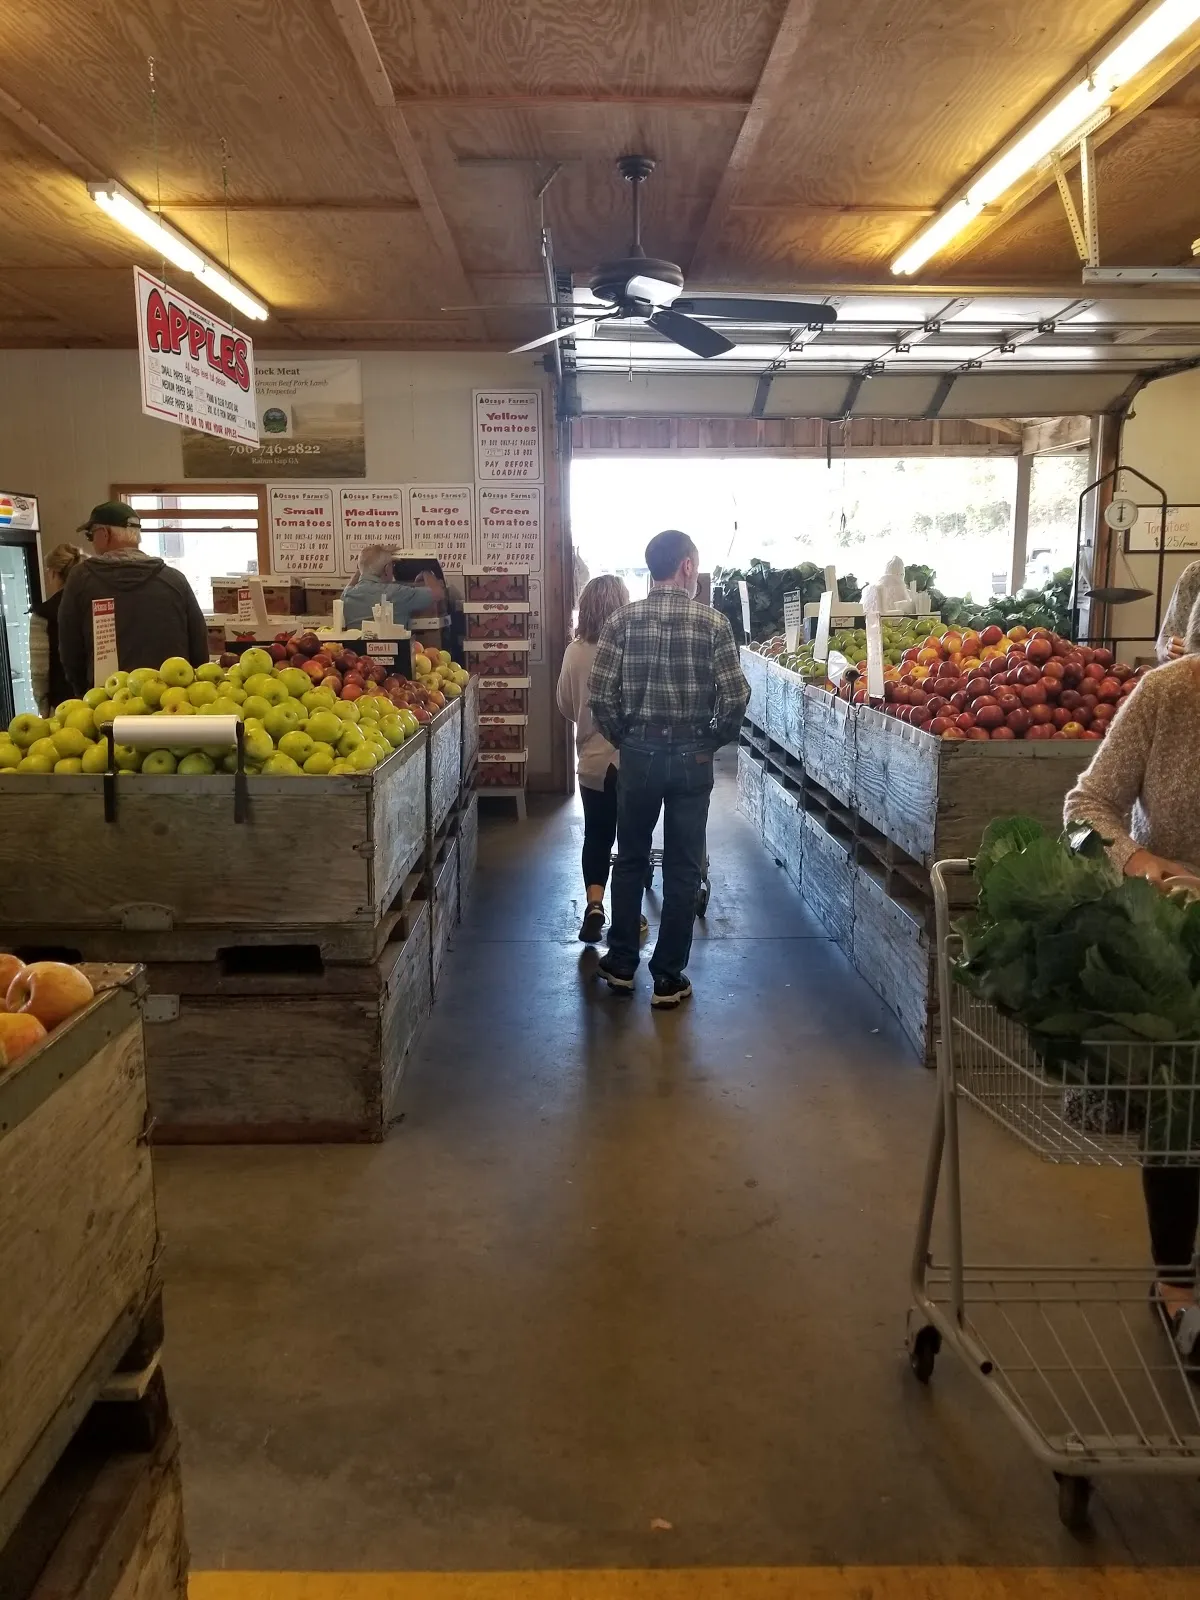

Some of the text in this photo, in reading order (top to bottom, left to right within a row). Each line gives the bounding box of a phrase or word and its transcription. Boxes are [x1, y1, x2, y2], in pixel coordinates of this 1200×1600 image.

[147, 288, 250, 392] APPLES
[174, 369, 183, 382] PAPER
[176, 384, 186, 396] PAPER
[175, 398, 185, 410] PAPER
[178, 412, 182, 422] IT
[185, 414, 189, 423] IS
[191, 416, 197, 426] OK
[198, 419, 204, 429] TO
[213, 423, 223, 434] YOUR
[480, 424, 536, 432] Tomatoes
[228, 443, 320, 456] 706-746-2822
[274, 458, 287, 466] Gap
[422, 506, 459, 514] Large
[274, 518, 332, 527] Tomatoes
[344, 518, 400, 527] Tomatoes
[413, 518, 469, 526] Tomatoes
[483, 517, 538, 526] Tomatoes
